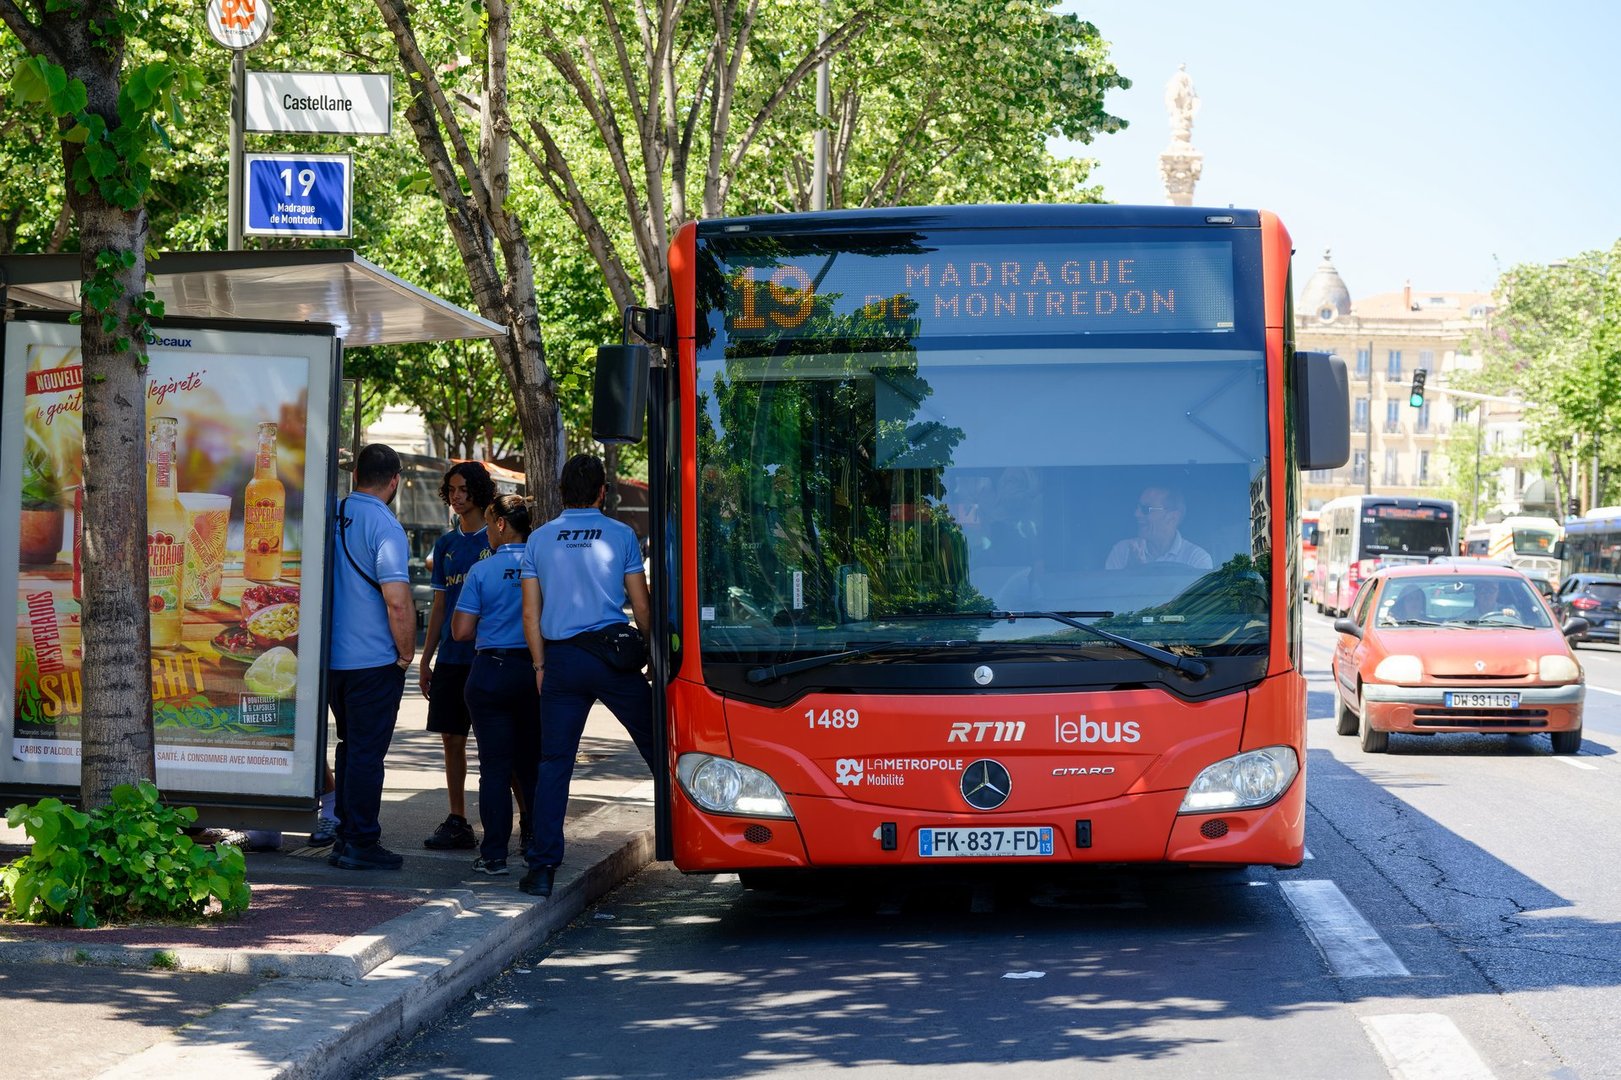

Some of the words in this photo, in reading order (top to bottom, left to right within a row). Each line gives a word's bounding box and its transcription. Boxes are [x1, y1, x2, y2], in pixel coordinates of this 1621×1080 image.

[283, 93, 352, 111] Castellane
[280, 168, 316, 197] 19
[277, 202, 316, 215] Madrague
[270, 214, 280, 224] de
[281, 214, 323, 225] Montredon
[905, 259, 1135, 287] MADRAGUE
[731, 264, 816, 329] 19
[864, 293, 909, 320] DE
[934, 289, 1175, 317] MONTREDON
[147, 335, 192, 348] Decaux
[46, 391, 83, 426] goût
[556, 529, 602, 541] RTM
[149, 566, 175, 577] NLIGHT
[503, 568, 522, 580] RT
[26, 590, 64, 674] DESPERADOS
[247, 695, 276, 705] BOUTEILLES
[253, 703, 276, 712] CAPSULES
[242, 713, 273, 724] TRIEZ-LES
[804, 708, 859, 729] 1489
[947, 720, 1026, 743] RTM
[1055, 714, 1141, 743] lebus
[20, 744, 42, 755] L'ABUS
[43, 746, 75, 757] D'ALCOOL
[157, 751, 180, 762] SANTÉ,
[180, 751, 186, 762] À
[187, 753, 228, 764] CONSOMMER
[229, 755, 246, 765] AVEC
[246, 754, 289, 767] MODÉRATION.
[1051, 766, 1115, 776] CITARO
[866, 773, 905, 786] Mobilité
[934, 830, 1039, 852] FK-837-FD
[1041, 843, 1051, 853] 13
